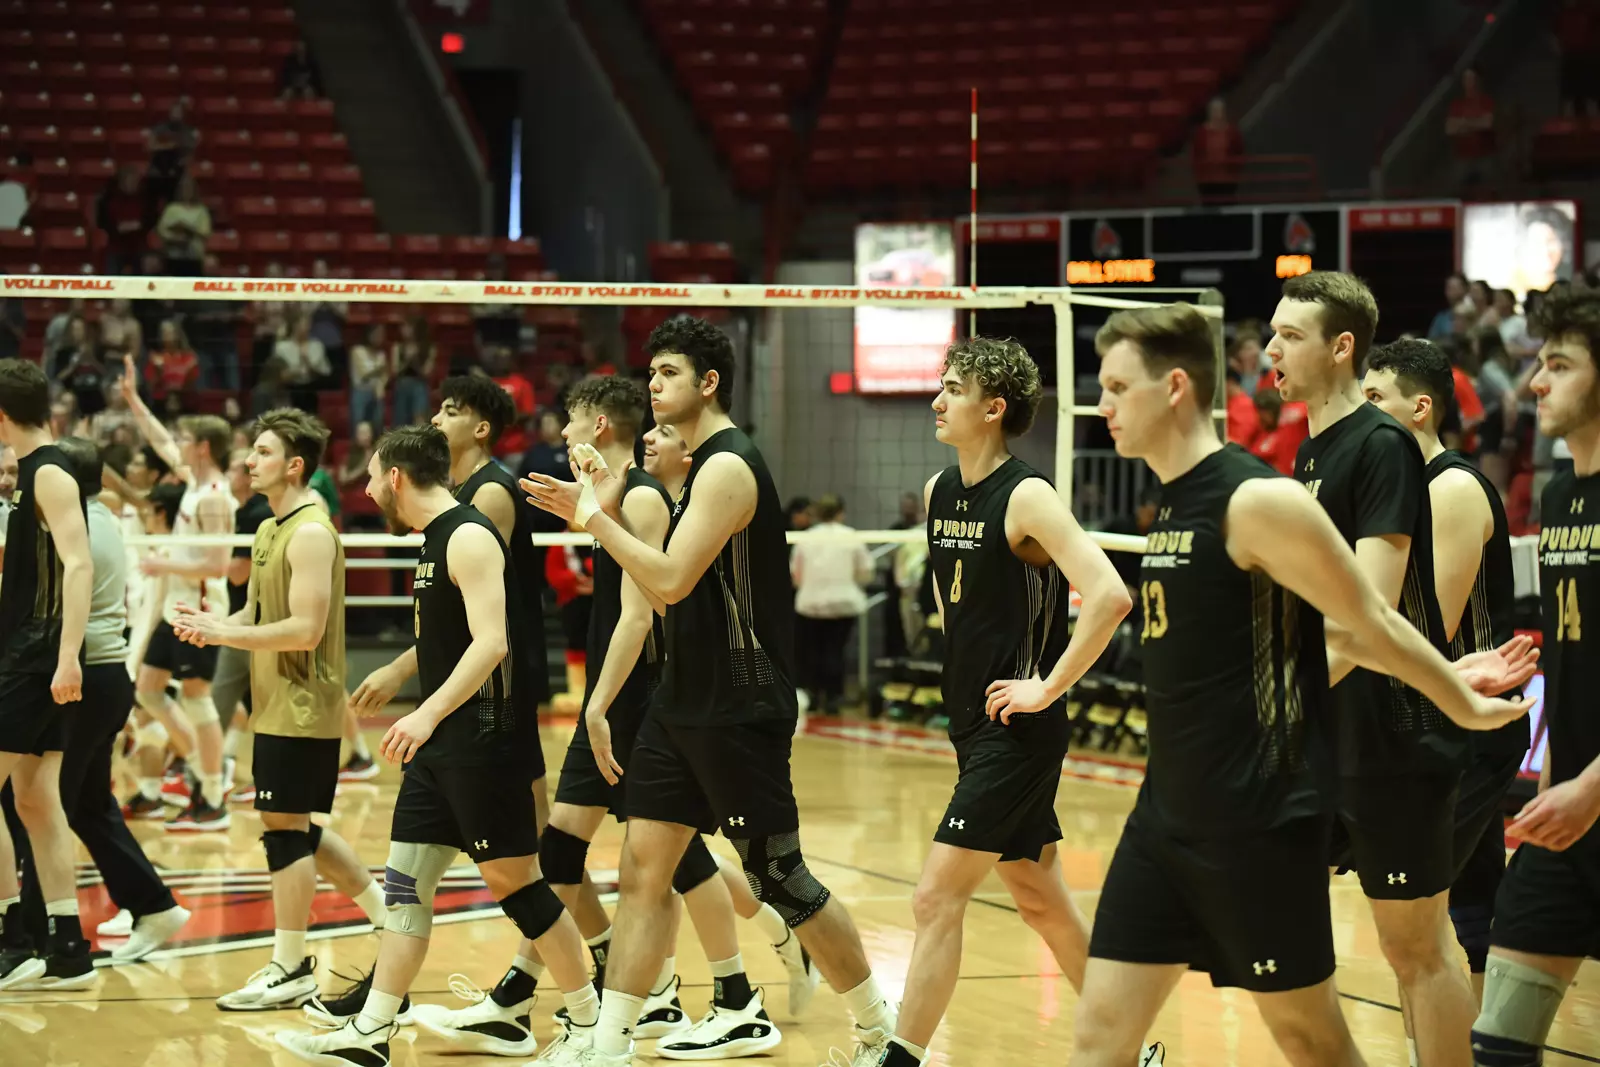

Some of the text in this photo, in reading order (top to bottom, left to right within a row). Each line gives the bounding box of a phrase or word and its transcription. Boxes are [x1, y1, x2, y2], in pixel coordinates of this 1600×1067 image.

[4, 278, 114, 290] VOLLEYBALL
[193, 281, 409, 294] BALL STATE VOLLEYBALL
[484, 285, 693, 298] BALL STATE VOLLEYBALL
[765, 288, 805, 299] BALL
[811, 289, 860, 300] STATE
[865, 289, 966, 300] VOLLEYBALL
[933, 519, 985, 538] PURDUE
[940, 538, 974, 550] FORT WAYNE
[1539, 524, 1600, 551] PURDUE
[1544, 551, 1588, 566] FORT WAYNE
[950, 559, 962, 604] 8
[1140, 580, 1168, 640] 13
[1556, 577, 1581, 642] 14
